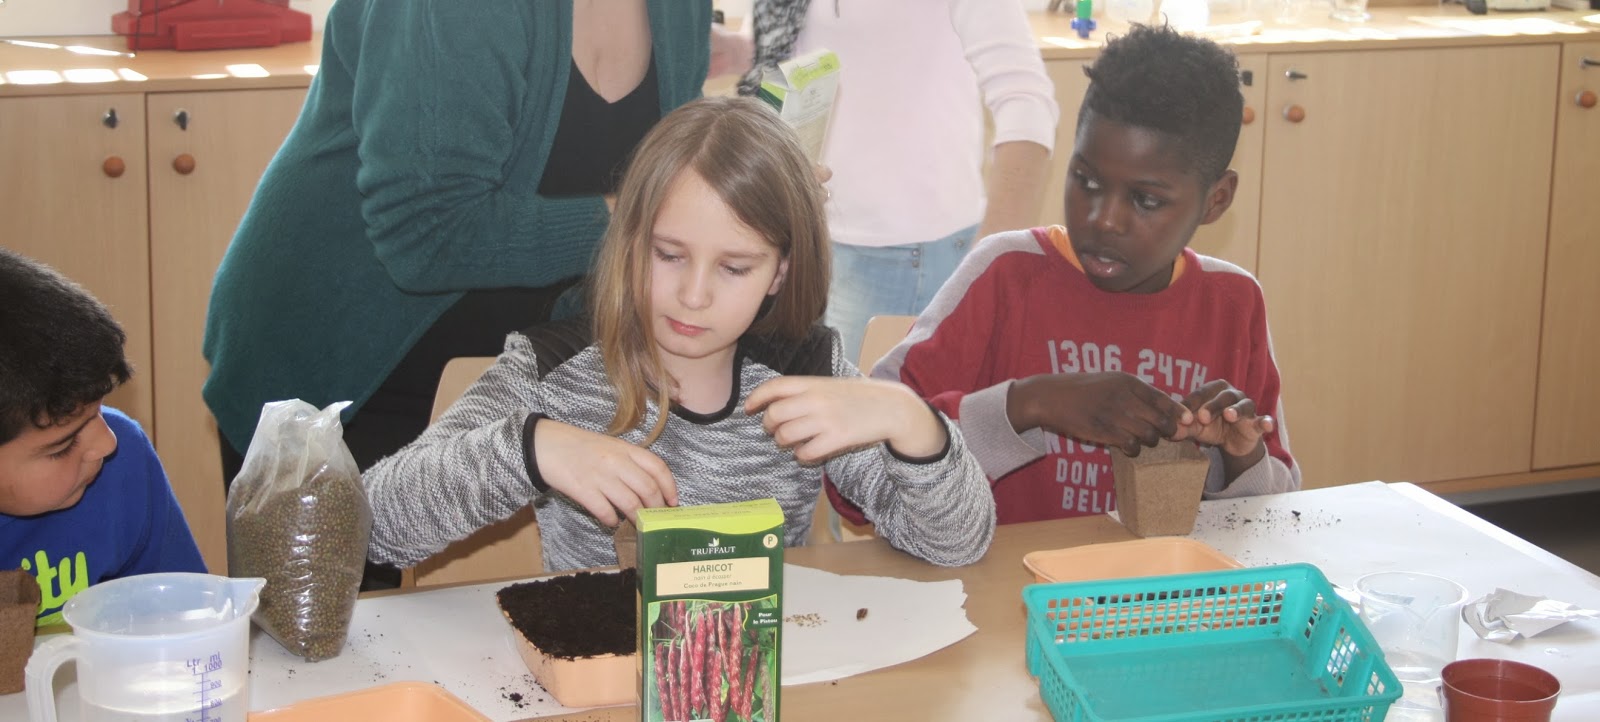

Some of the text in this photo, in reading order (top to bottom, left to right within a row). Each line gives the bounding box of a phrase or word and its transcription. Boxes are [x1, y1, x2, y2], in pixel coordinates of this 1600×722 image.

[1136, 349, 1208, 391] 24TH
[1056, 457, 1113, 487] DON'
[1062, 486, 1118, 513] BELI
[767, 536, 774, 545] P
[691, 546, 736, 556] TRUFFAUT
[693, 563, 733, 574] HARICOT
[21, 550, 89, 614] ty
[210, 651, 221, 662] ml
[204, 660, 222, 672] 1000
